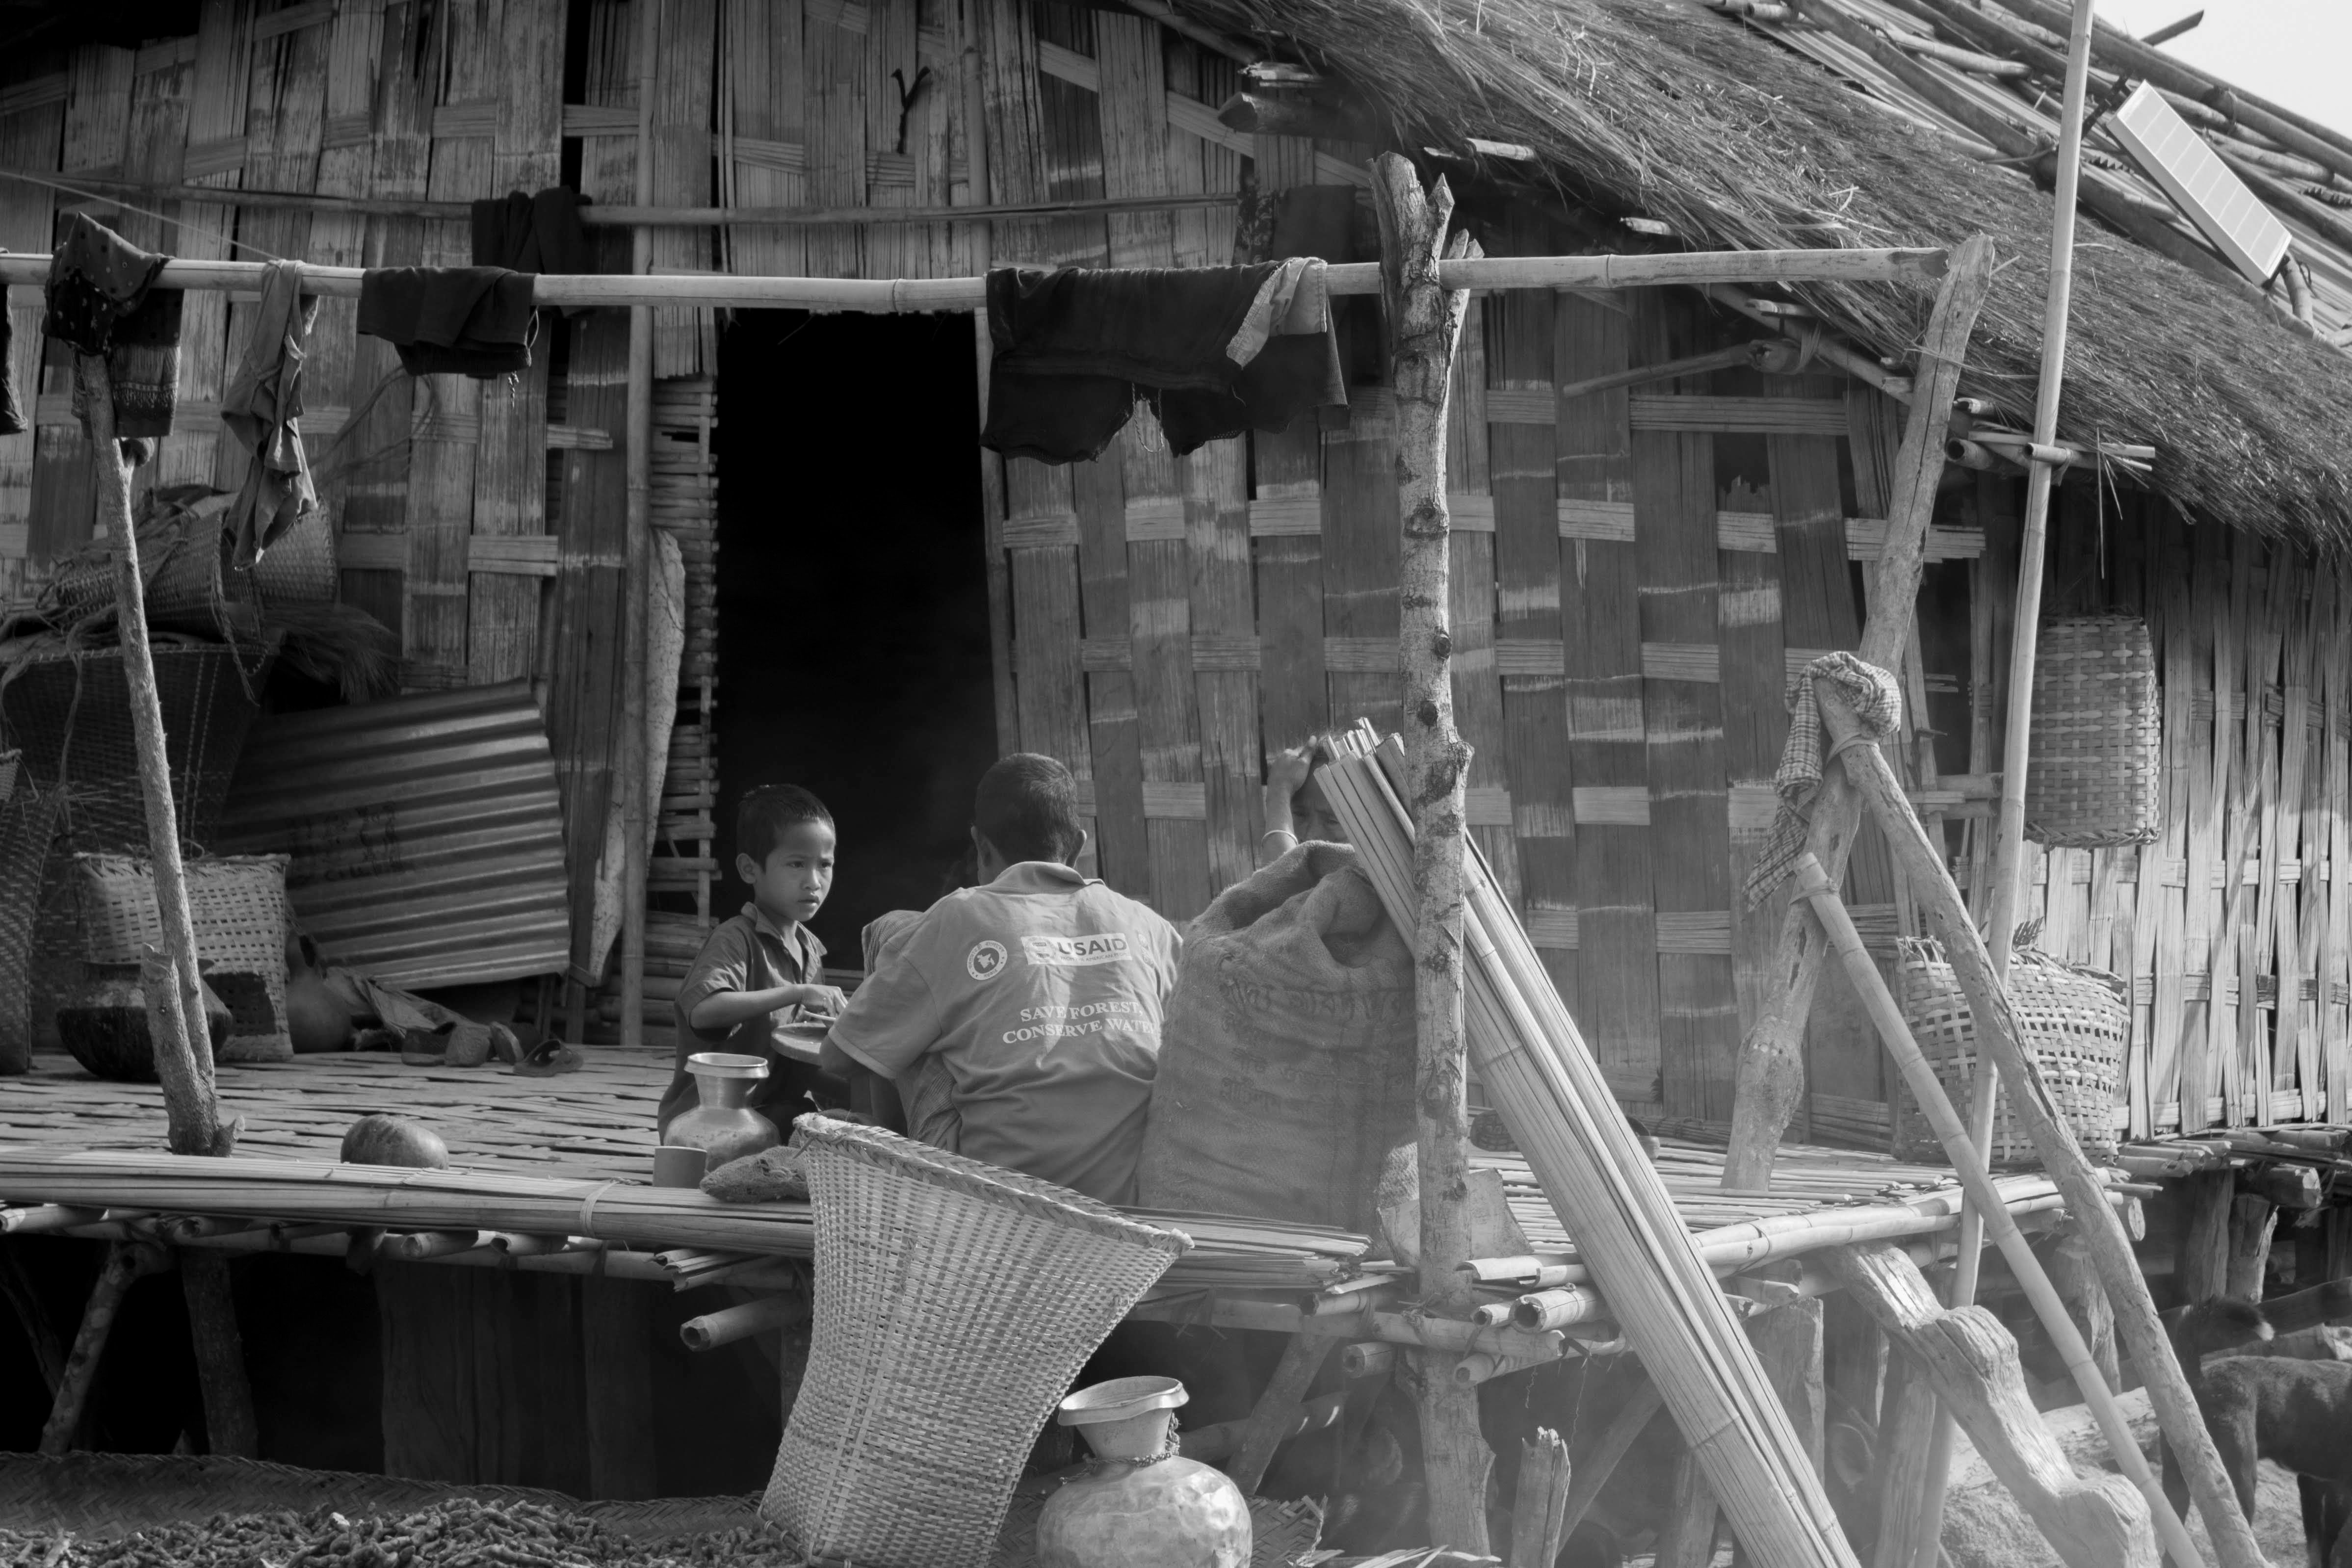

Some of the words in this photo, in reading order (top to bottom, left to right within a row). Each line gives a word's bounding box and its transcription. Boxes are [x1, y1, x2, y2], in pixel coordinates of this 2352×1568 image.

[1057, 938, 1127, 956] USAID
[1020, 1005, 1067, 1022] SAVE
[1069, 1001, 1143, 1019] FOREST,
[1003, 1020, 1103, 1044] CONSERVE
